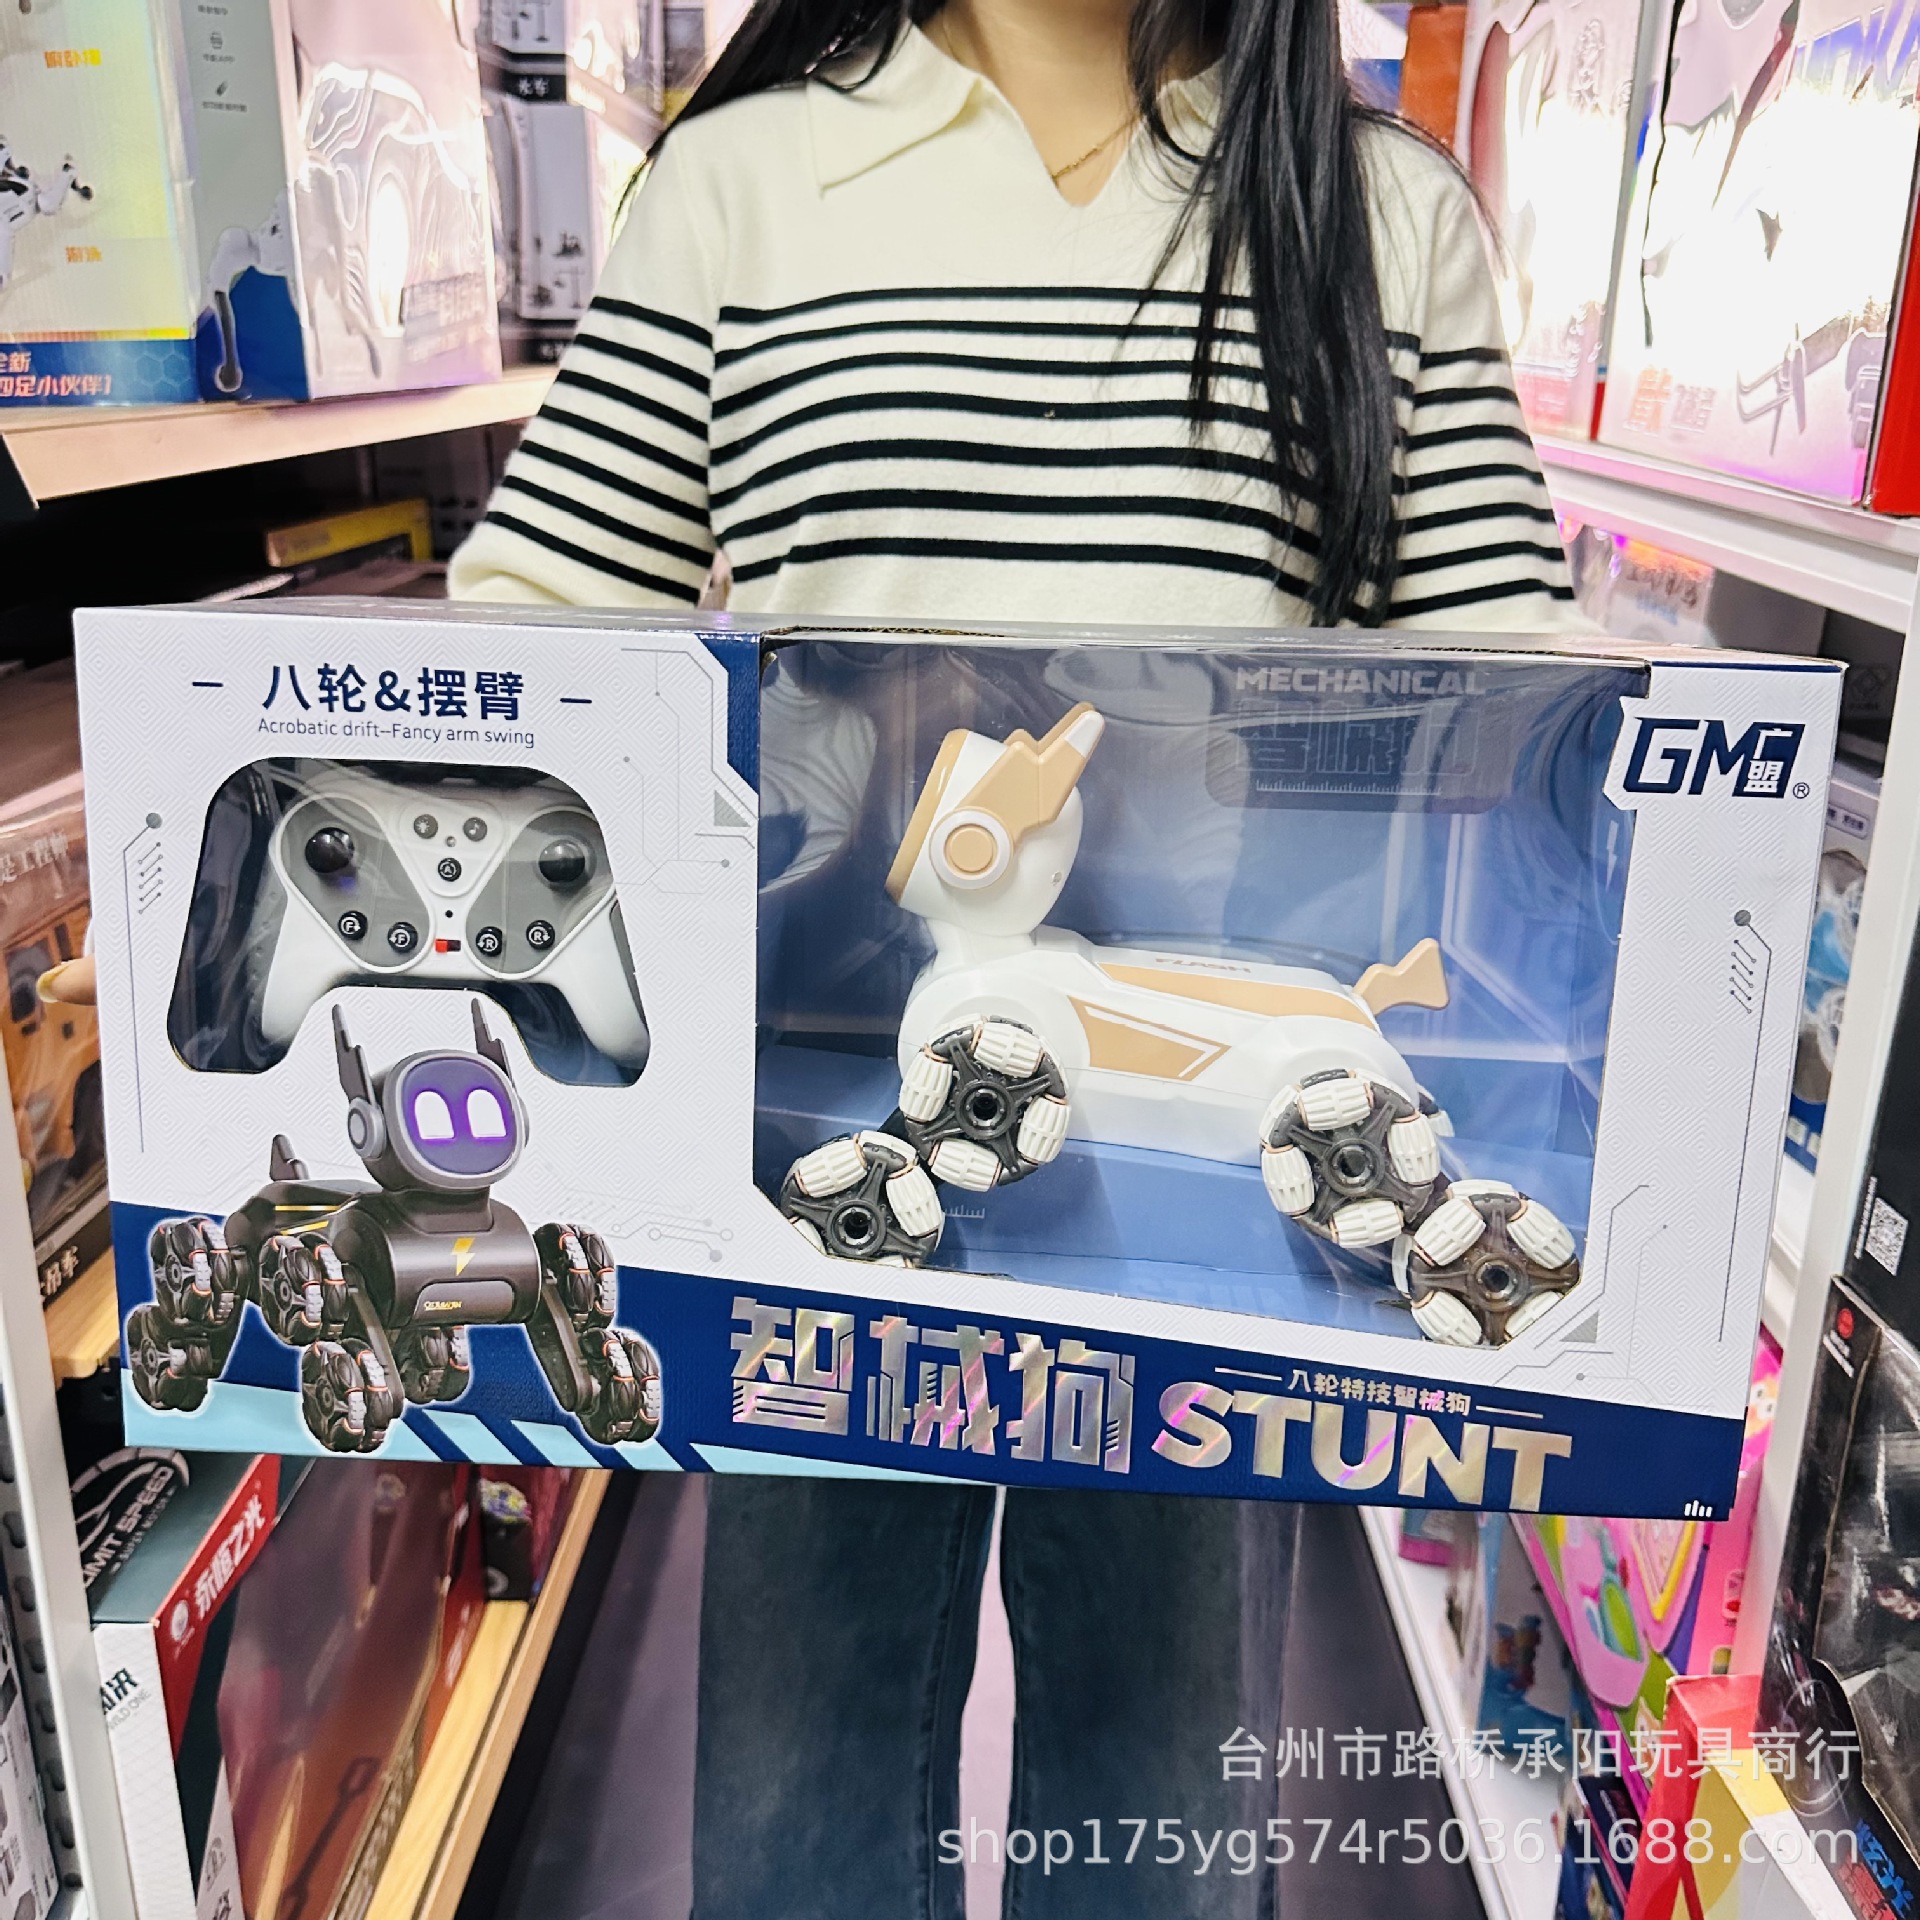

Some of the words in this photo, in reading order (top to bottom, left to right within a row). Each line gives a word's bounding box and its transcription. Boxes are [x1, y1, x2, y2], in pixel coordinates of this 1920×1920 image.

[262, 663, 524, 721] 八轮&摆臂
[1236, 666, 1487, 696] MECHANICAL
[258, 717, 339, 736] Acrobatic
[447, 728, 480, 743] arm
[484, 728, 535, 750] swing
[41, 1245, 79, 1303] 吊车
[730, 1296, 1136, 1474] 智械狗
[1288, 1369, 1472, 1416] 八轮特技智械狗
[1151, 1381, 1573, 1512] STUNT
[115, 1465, 174, 1533] SPEED
